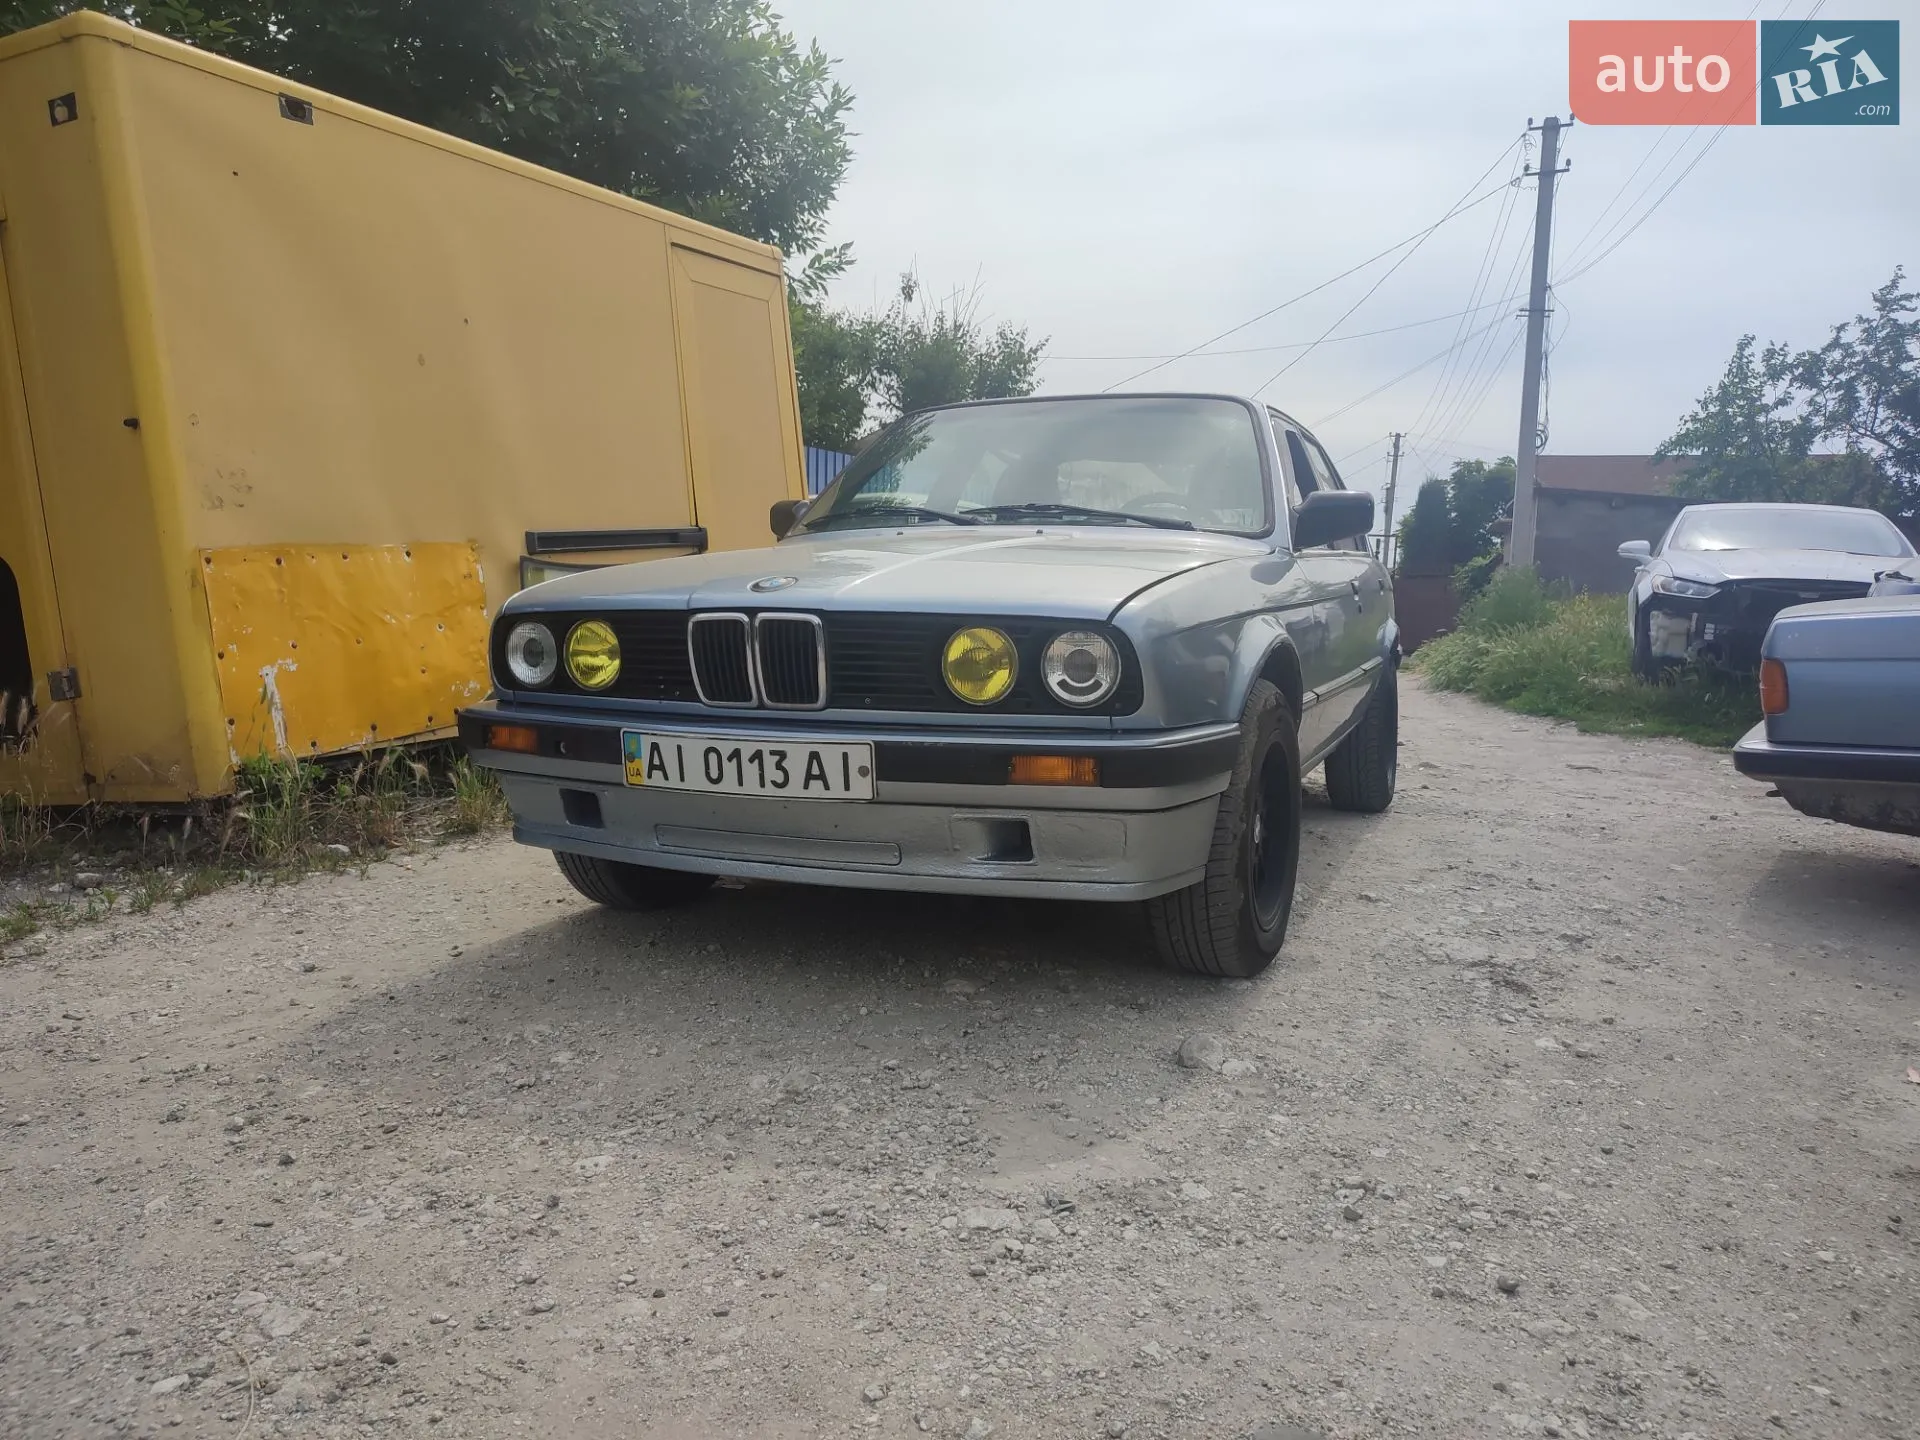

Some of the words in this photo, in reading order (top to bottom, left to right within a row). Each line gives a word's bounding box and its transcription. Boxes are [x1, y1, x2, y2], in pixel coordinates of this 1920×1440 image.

[628, 767, 642, 777] UA
[647, 742, 685, 782] AI
[703, 746, 790, 789] 0113
[803, 751, 850, 791] AI
